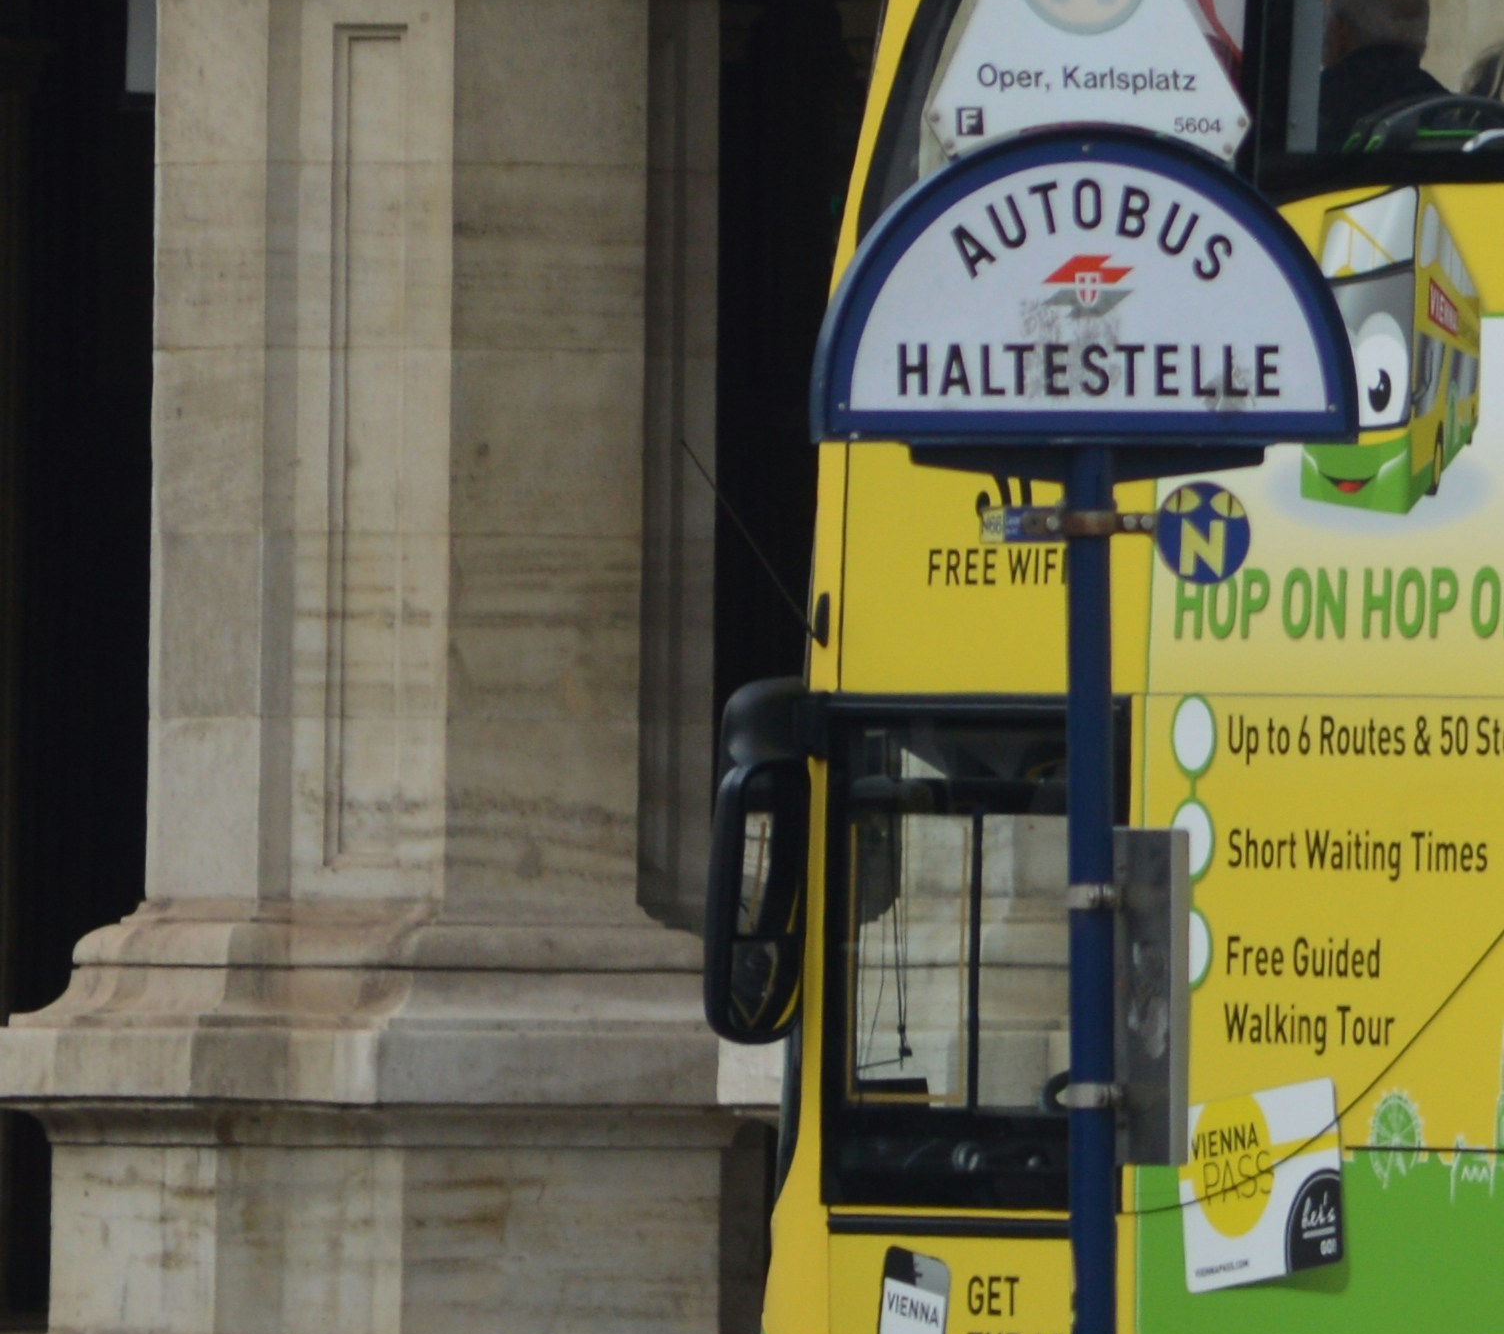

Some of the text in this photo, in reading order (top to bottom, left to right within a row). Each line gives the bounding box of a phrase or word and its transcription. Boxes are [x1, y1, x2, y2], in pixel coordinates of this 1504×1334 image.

[977, 62, 1197, 95] Oper, Karlsplatz
[1173, 118, 1222, 135] 5604
[950, 177, 1234, 282] AUTOBUS
[896, 342, 1281, 397] HALTESTELLE
[927, 547, 996, 586] FREE
[1178, 517, 1227, 579] N
[1174, 567, 1270, 640] HOP
[1282, 566, 1348, 640] ON
[1361, 566, 1459, 640] HOP
[1228, 714, 1260, 766] Up
[1268, 716, 1291, 756] to
[1298, 715, 1311, 756] 6
[1320, 715, 1406, 756] Routes
[1414, 716, 1432, 756] &
[1440, 716, 1469, 756] 50
[1227, 828, 1488, 883] Short Waiting Times
[1226, 935, 1381, 979] Free Guided
[1224, 1002, 1395, 1057] Walking Tour
[1191, 1121, 1260, 1162] VIENNA
[1202, 1149, 1275, 1207] PASS
[887, 1290, 940, 1329] VIENNA
[967, 1275, 1020, 1317] GET
